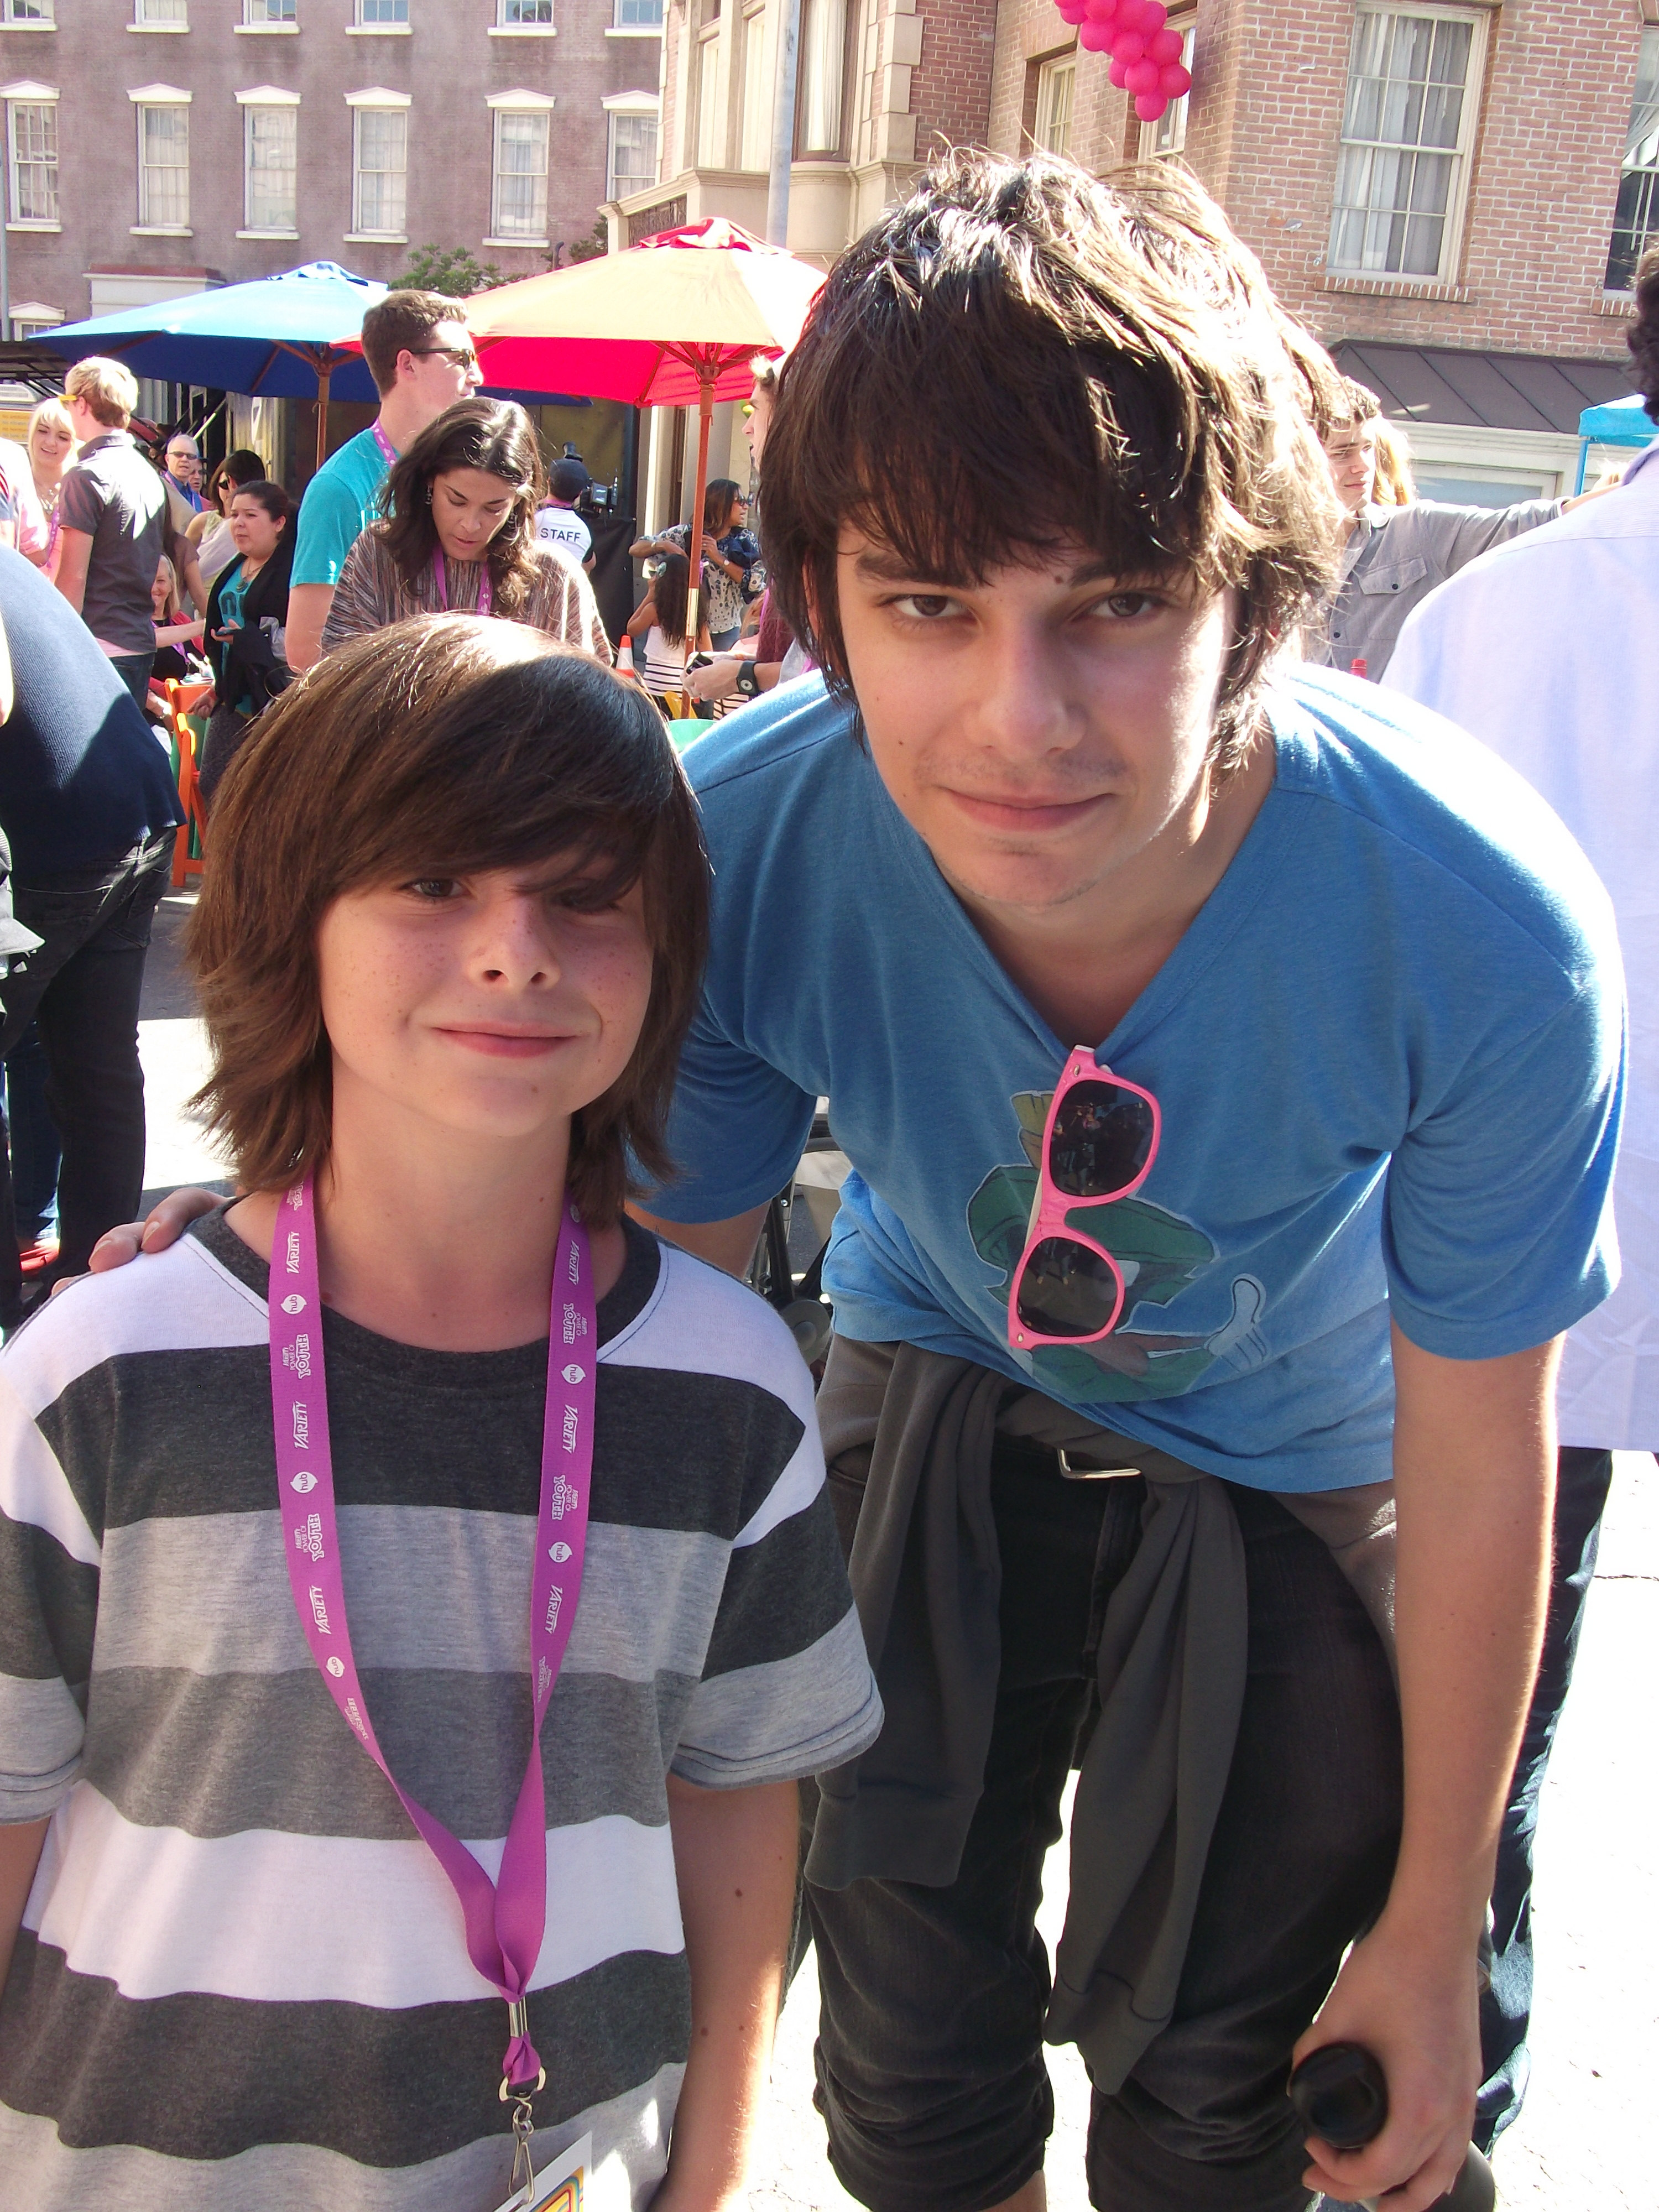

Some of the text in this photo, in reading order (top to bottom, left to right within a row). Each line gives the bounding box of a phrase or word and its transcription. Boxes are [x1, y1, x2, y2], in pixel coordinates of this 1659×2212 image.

[540, 528, 581, 542] STAFF
[293, 1181, 304, 1211] YOU
[286, 1231, 300, 1274] VARIETY
[568, 1240, 580, 1285] VARIETY
[289, 1295, 298, 1312] hub
[563, 1303, 576, 1344] YOUTH
[296, 1334, 311, 1379] YOUTH
[570, 1366, 578, 1383] hub
[293, 1400, 309, 1450] VARIETY
[562, 1404, 578, 1454] VARIETY
[299, 1473, 307, 1491] hub
[552, 1475, 566, 1520] YOUTH
[307, 1514, 324, 1562] YOUTH
[555, 1544, 564, 1561] hub
[309, 1585, 332, 1635] VARIETY
[545, 1584, 563, 1634] VARIETY
[332, 1658, 340, 1674] hub
